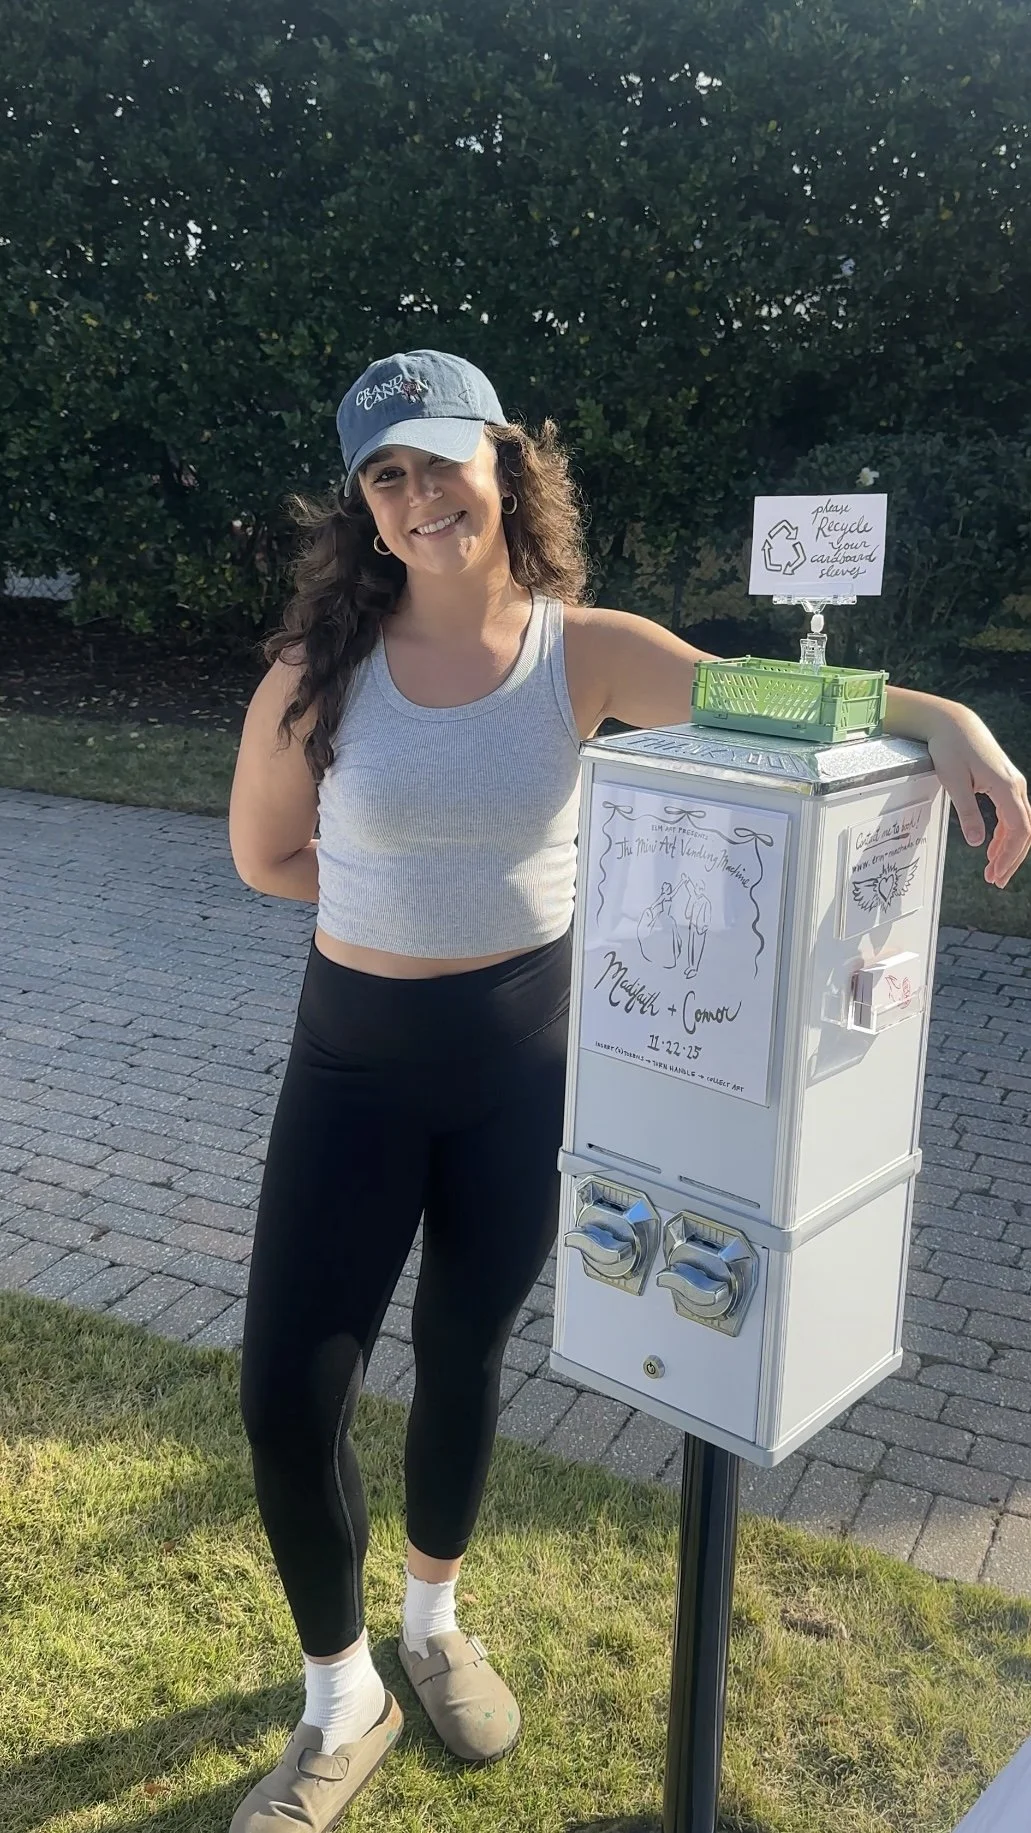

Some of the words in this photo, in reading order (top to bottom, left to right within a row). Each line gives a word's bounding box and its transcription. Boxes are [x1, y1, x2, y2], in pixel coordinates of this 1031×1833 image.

[356, 374, 404, 407] GRAND
[811, 498, 851, 526] please
[815, 515, 873, 543] Recycle
[810, 545, 880, 564] cardboard
[828, 540, 871, 557] your
[818, 564, 867, 579] sleeves
[664, 825, 676, 833] ART
[678, 826, 709, 841] PRESENTS
[855, 826, 881, 850] Contact
[881, 827, 892, 838] me
[892, 820, 900, 835] to
[614, 836, 633, 860] The
[635, 836, 658, 857] Mini
[659, 835, 678, 859] Art
[681, 837, 719, 873] Vending
[717, 848, 751, 889] Machine
[667, 1003, 677, 1017] +
[682, 990, 743, 1035] Connor
[595, 1041, 614, 1052] INSERT
[652, 1060, 668, 1070] TURN
[669, 1065, 696, 1077] HANDLE
[706, 1076, 730, 1088] COLLECT
[731, 1084, 745, 1093] ART
